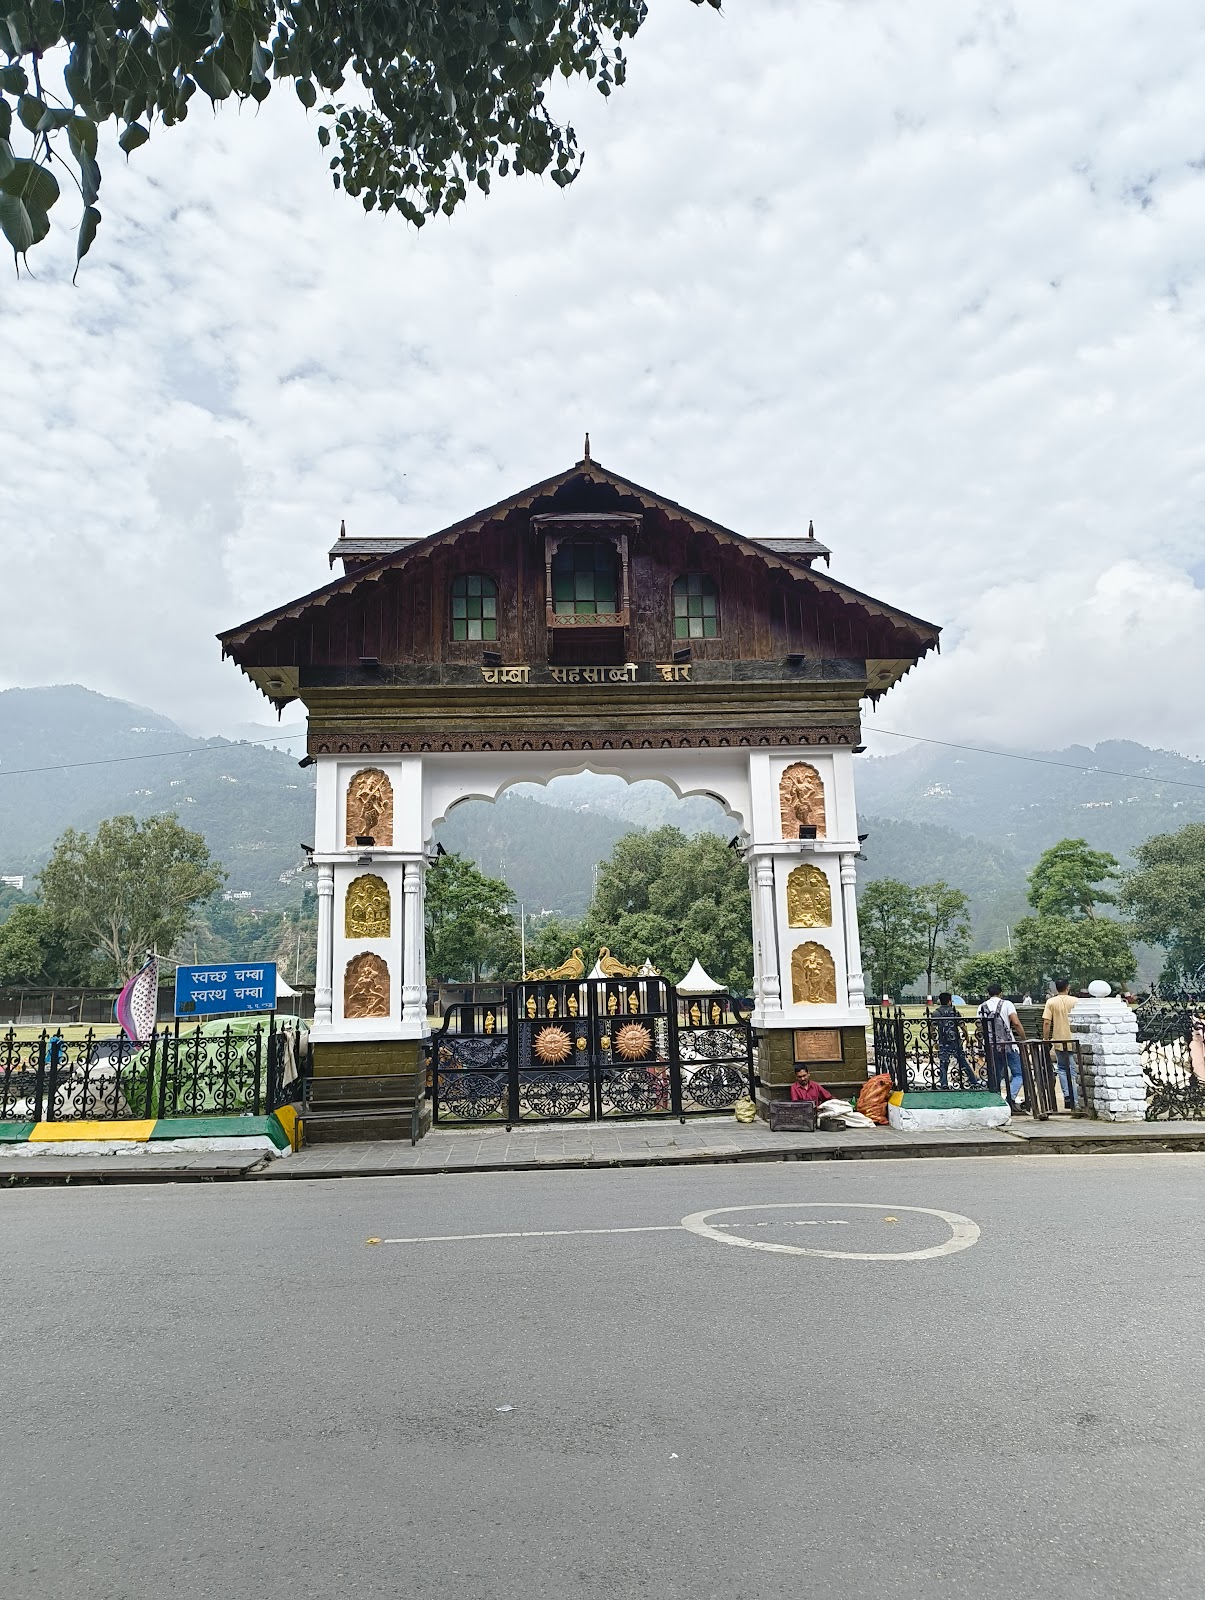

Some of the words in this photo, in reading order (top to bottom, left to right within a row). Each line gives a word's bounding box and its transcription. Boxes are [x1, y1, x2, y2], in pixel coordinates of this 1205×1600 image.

[481, 666, 531, 683] चम्बा
[656, 664, 692, 682] द्वार
[190, 971, 228, 984] स्वच्छ
[234, 969, 264, 982] चम्बा
[190, 989, 227, 1002] स्वस्थ
[233, 987, 264, 1000] चम्बा
